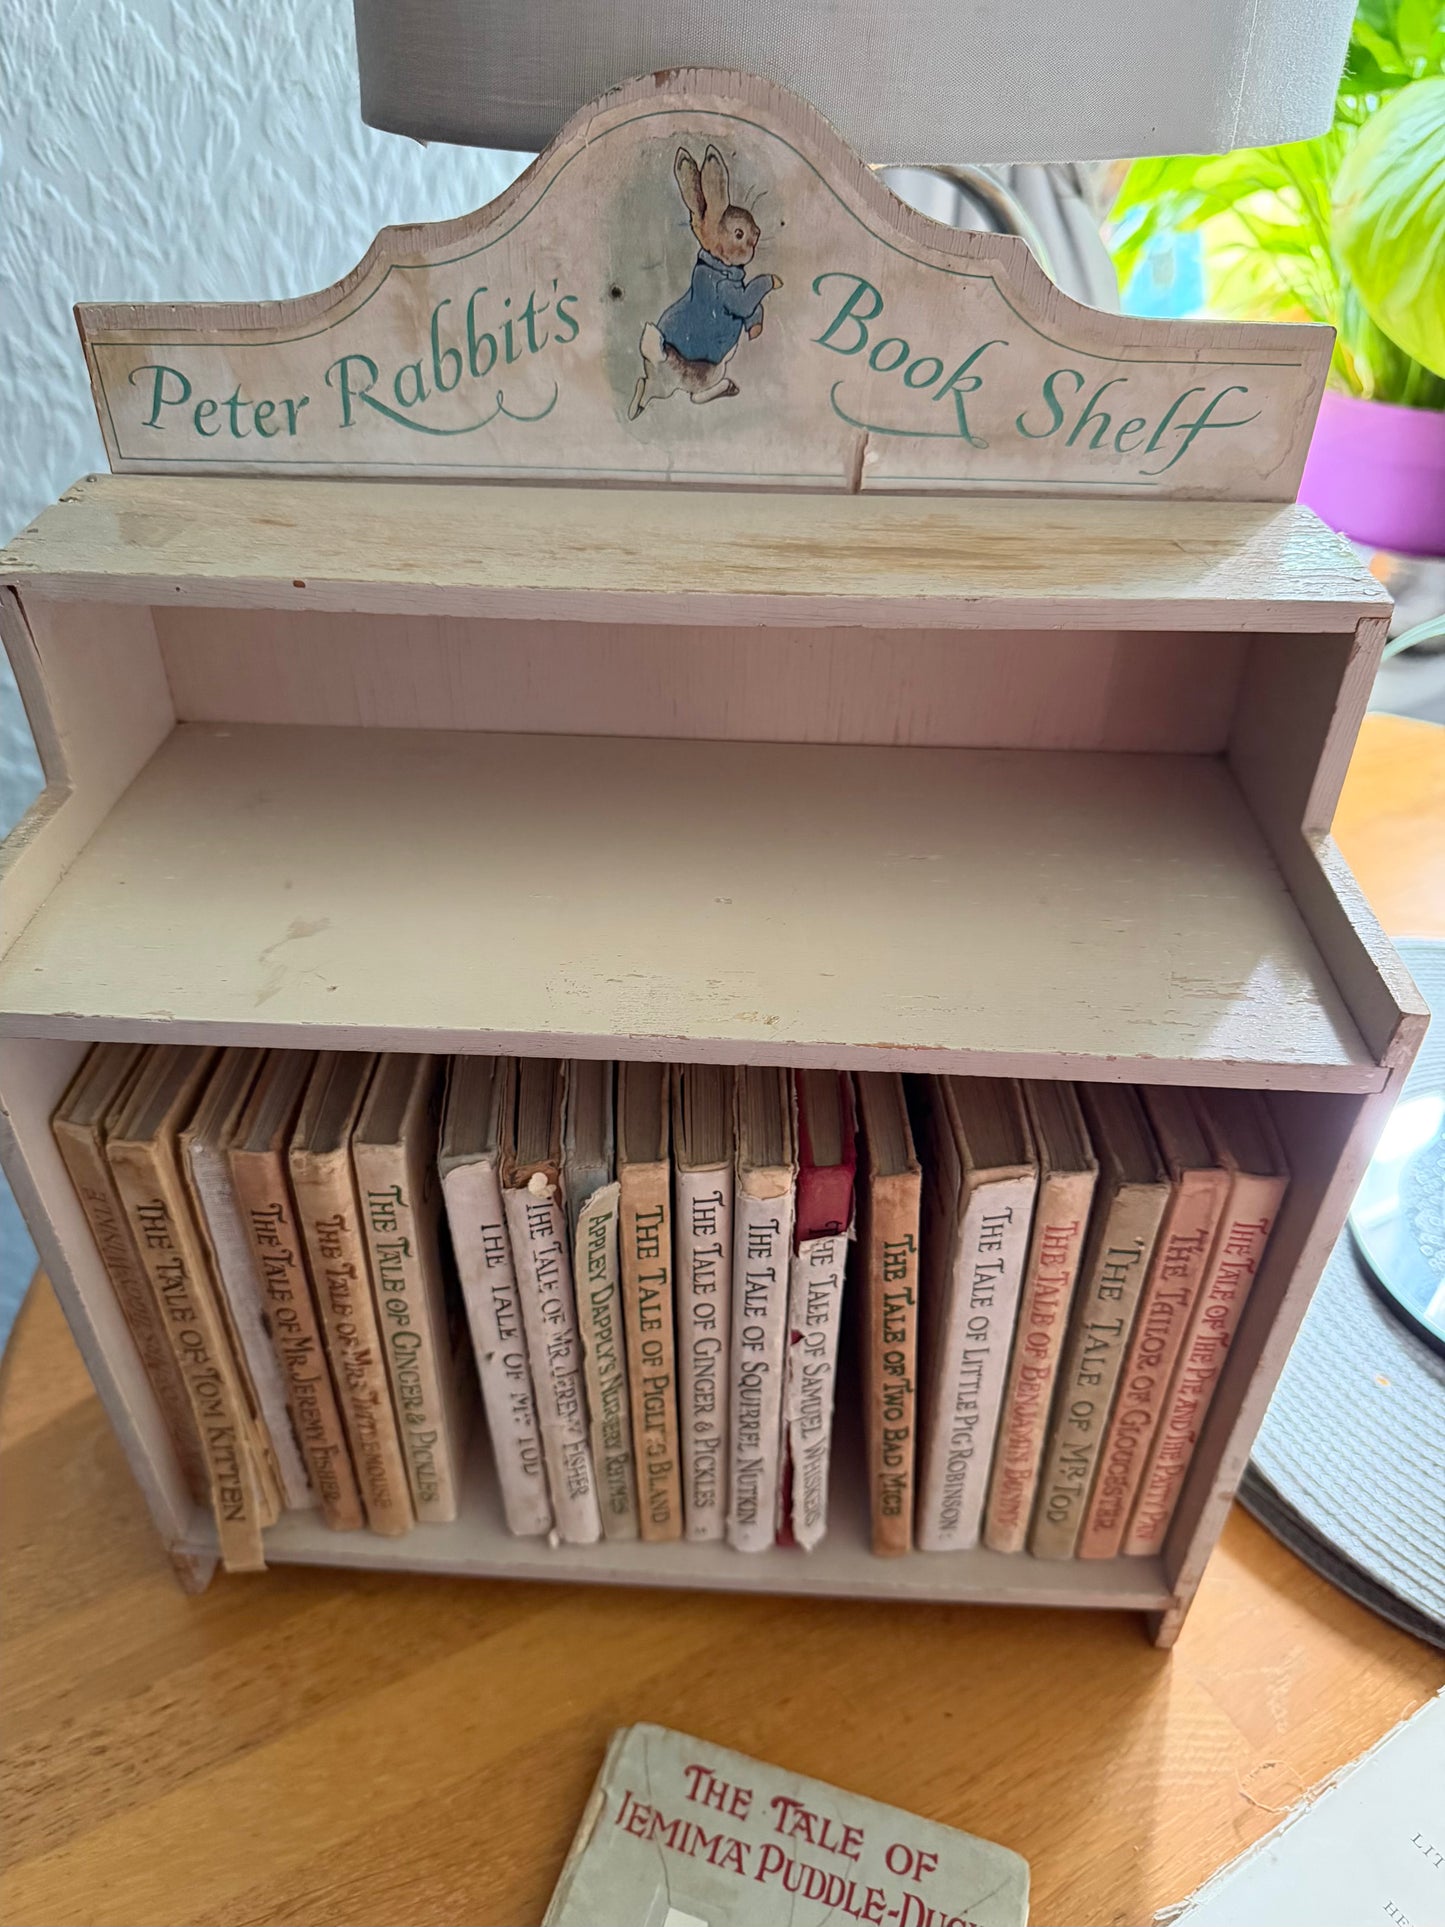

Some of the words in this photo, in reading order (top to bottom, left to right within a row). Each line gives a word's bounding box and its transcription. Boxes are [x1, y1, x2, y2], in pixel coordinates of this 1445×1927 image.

[128, 364, 311, 438] Peter
[324, 278, 581, 436] Rabbit's
[810, 272, 1009, 450] Book
[1015, 368, 1262, 476] Shelf
[136, 1199, 175, 1249] THE
[250, 1203, 287, 1247] THE
[368, 1185, 410, 1232] THE
[526, 1197, 555, 1240] THE
[635, 1204, 664, 1260] THE
[692, 1190, 726, 1237] THE
[978, 1207, 1012, 1252] THE
[315, 1214, 351, 1259] THE
[481, 1222, 507, 1268] THE
[588, 1211, 613, 1282] APPLEY
[747, 1219, 780, 1259] THE
[806, 1221, 843, 1267] THE
[883, 1234, 917, 1282] THE
[1039, 1220, 1079, 1267] THE
[1161, 1228, 1210, 1281] THE
[1223, 1218, 1270, 1255] THE
[156, 1257, 197, 1321] TALE
[262, 1249, 296, 1300] TALE
[325, 1262, 359, 1315] TALE
[376, 1236, 414, 1292] TALE
[533, 1241, 563, 1293] TALE
[692, 1242, 724, 1295] TALE
[970, 1258, 1004, 1309] TALE
[1097, 1240, 1146, 1300] THE
[1207, 1258, 1255, 1301] TALE
[385, 1298, 410, 1327] OF
[491, 1285, 518, 1340] TALE
[541, 1299, 566, 1325] OF
[638, 1267, 667, 1332] TALE
[693, 1302, 716, 1331] OF
[744, 1267, 776, 1316] TALE
[805, 1273, 838, 1326] TALE
[883, 1287, 916, 1344] TALE
[1030, 1271, 1071, 1327] TALE
[275, 1308, 301, 1334] OF
[336, 1322, 359, 1348] OF
[591, 1282, 617, 1376] DAPPLY'S
[741, 1325, 765, 1353] OF
[965, 1316, 990, 1341] OF
[1137, 1287, 1192, 1371] TAILOR
[1202, 1305, 1230, 1332] OF
[180, 1329, 211, 1364] OF
[391, 1331, 422, 1410] GINGER
[503, 1352, 528, 1381] OF
[642, 1339, 664, 1367] OF
[803, 1332, 826, 1359] OF
[883, 1351, 906, 1376] OF
[1024, 1331, 1052, 1361] OF
[1076, 1318, 1125, 1387] TALE
[1189, 1331, 1230, 1364] THE
[193, 1367, 226, 1418] TOM
[692, 1337, 722, 1417] GINGER
[799, 1361, 832, 1440] SAMUEL
[883, 1378, 914, 1421] TWO
[955, 1348, 990, 1411] LITTLE
[1128, 1375, 1155, 1403] OF
[1179, 1366, 1218, 1395] PIE
[290, 1370, 331, 1443] JEREMY
[405, 1412, 427, 1427] &
[600, 1370, 623, 1450] NURSERY
[642, 1374, 670, 1457] PIGLIG
[693, 1420, 714, 1434] &
[737, 1361, 770, 1453] SQUIRREL
[951, 1414, 980, 1445] PIG
[1008, 1364, 1051, 1464] BENJAMIN
[1068, 1400, 1096, 1432] OF
[1169, 1398, 1198, 1432] AND
[409, 1430, 440, 1504] PICKLES
[562, 1437, 590, 1500] FISHER
[883, 1426, 910, 1467] BAD
[1160, 1430, 1197, 1460] THE
[209, 1426, 246, 1522] KITTEN
[309, 1443, 341, 1501] FISHER
[605, 1451, 631, 1515] RHYMES
[648, 1460, 673, 1525] BLAND
[693, 1436, 722, 1509] PICKLES
[737, 1457, 764, 1525] NUTKIN
[803, 1438, 826, 1528] WHISKERS
[879, 1472, 908, 1517] MICE
[939, 1447, 974, 1531] ROBINSON
[1093, 1409, 1151, 1532] GLOUCESTER
[1147, 1462, 1185, 1508] PATTY
[998, 1468, 1034, 1528] BUNNY
[1046, 1483, 1082, 1523] TOD
[1135, 1509, 1169, 1541] PAN
[614, 1790, 751, 1876] JEMIMA
[684, 1763, 753, 1822] THE
[770, 1795, 865, 1861] TALE
[884, 1842, 939, 1883] OF
